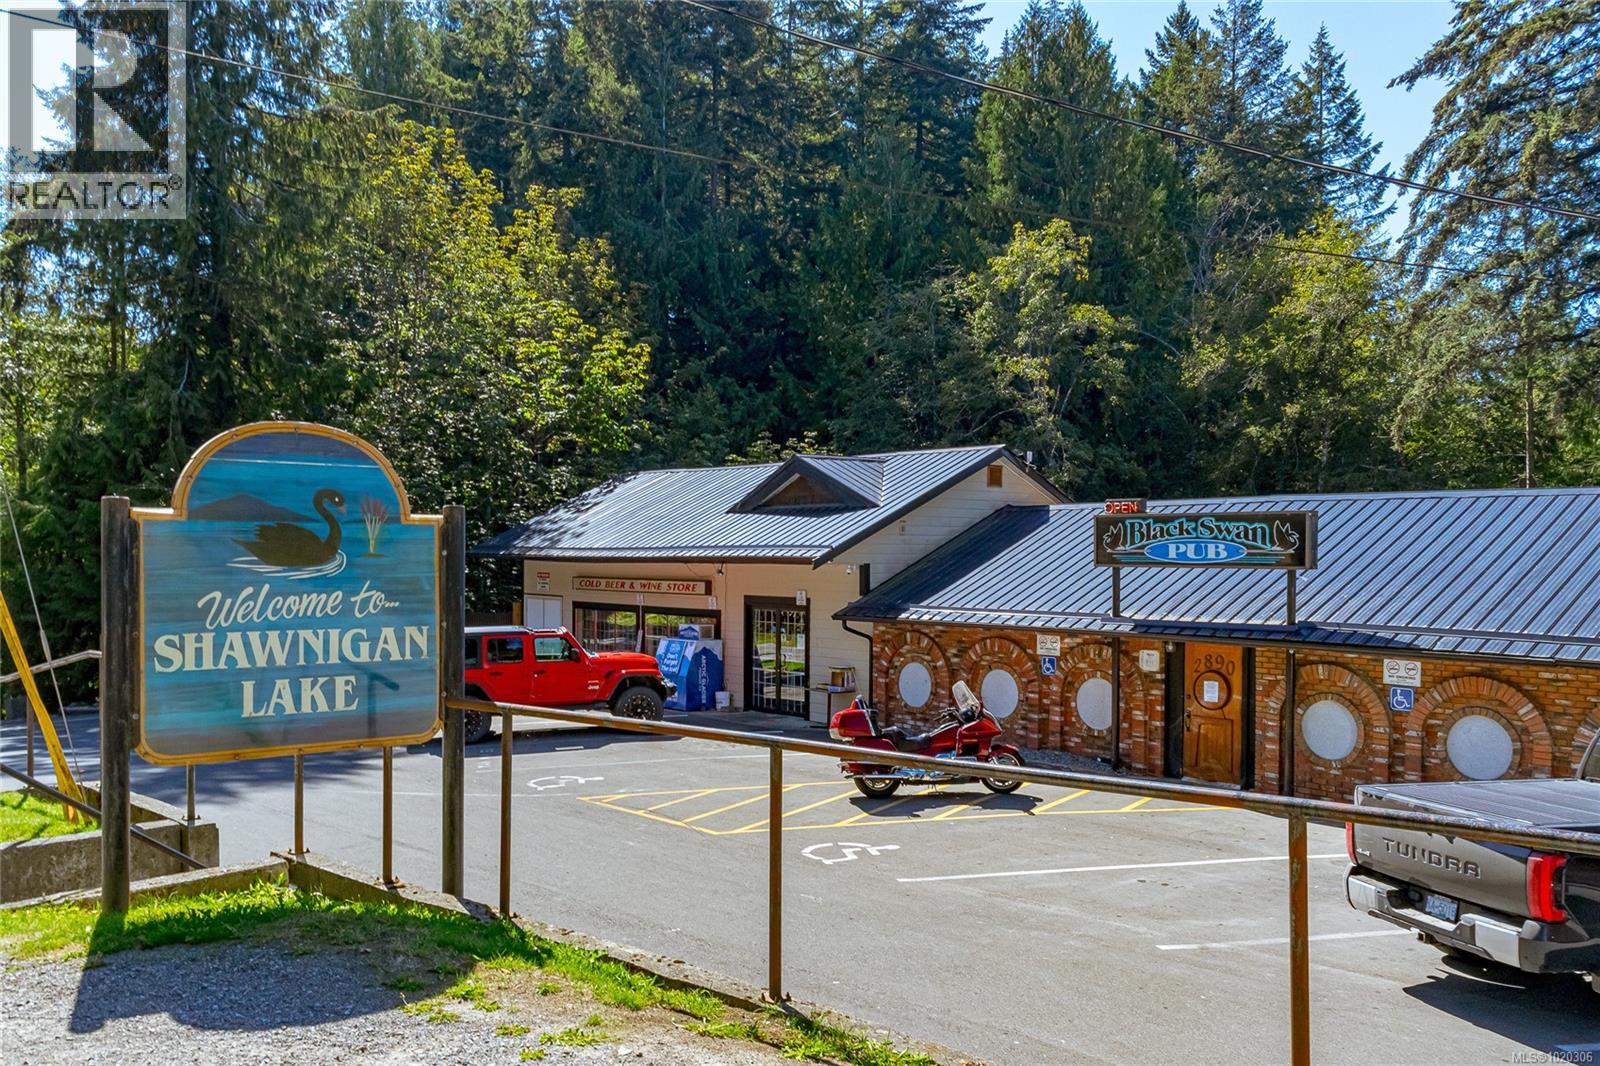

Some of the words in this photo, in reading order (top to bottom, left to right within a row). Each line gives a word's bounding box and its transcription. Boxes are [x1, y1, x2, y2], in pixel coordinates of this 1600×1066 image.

[1104, 501, 1138, 514] OPEN
[1125, 517, 1196, 550] Black
[1198, 516, 1273, 551] Swan
[1167, 543, 1228, 560] PUB
[579, 579, 601, 589] COLD
[605, 580, 626, 590] BEER
[628, 580, 636, 590] &
[639, 581, 663, 591] WINE
[666, 582, 698, 593] STORE
[196, 583, 343, 631] Welcome
[153, 625, 430, 673] SHAWNIGAN
[1193, 654, 1236, 677] 2890
[240, 674, 360, 719] LAKE
[1381, 837, 1482, 880] TUNDRA
